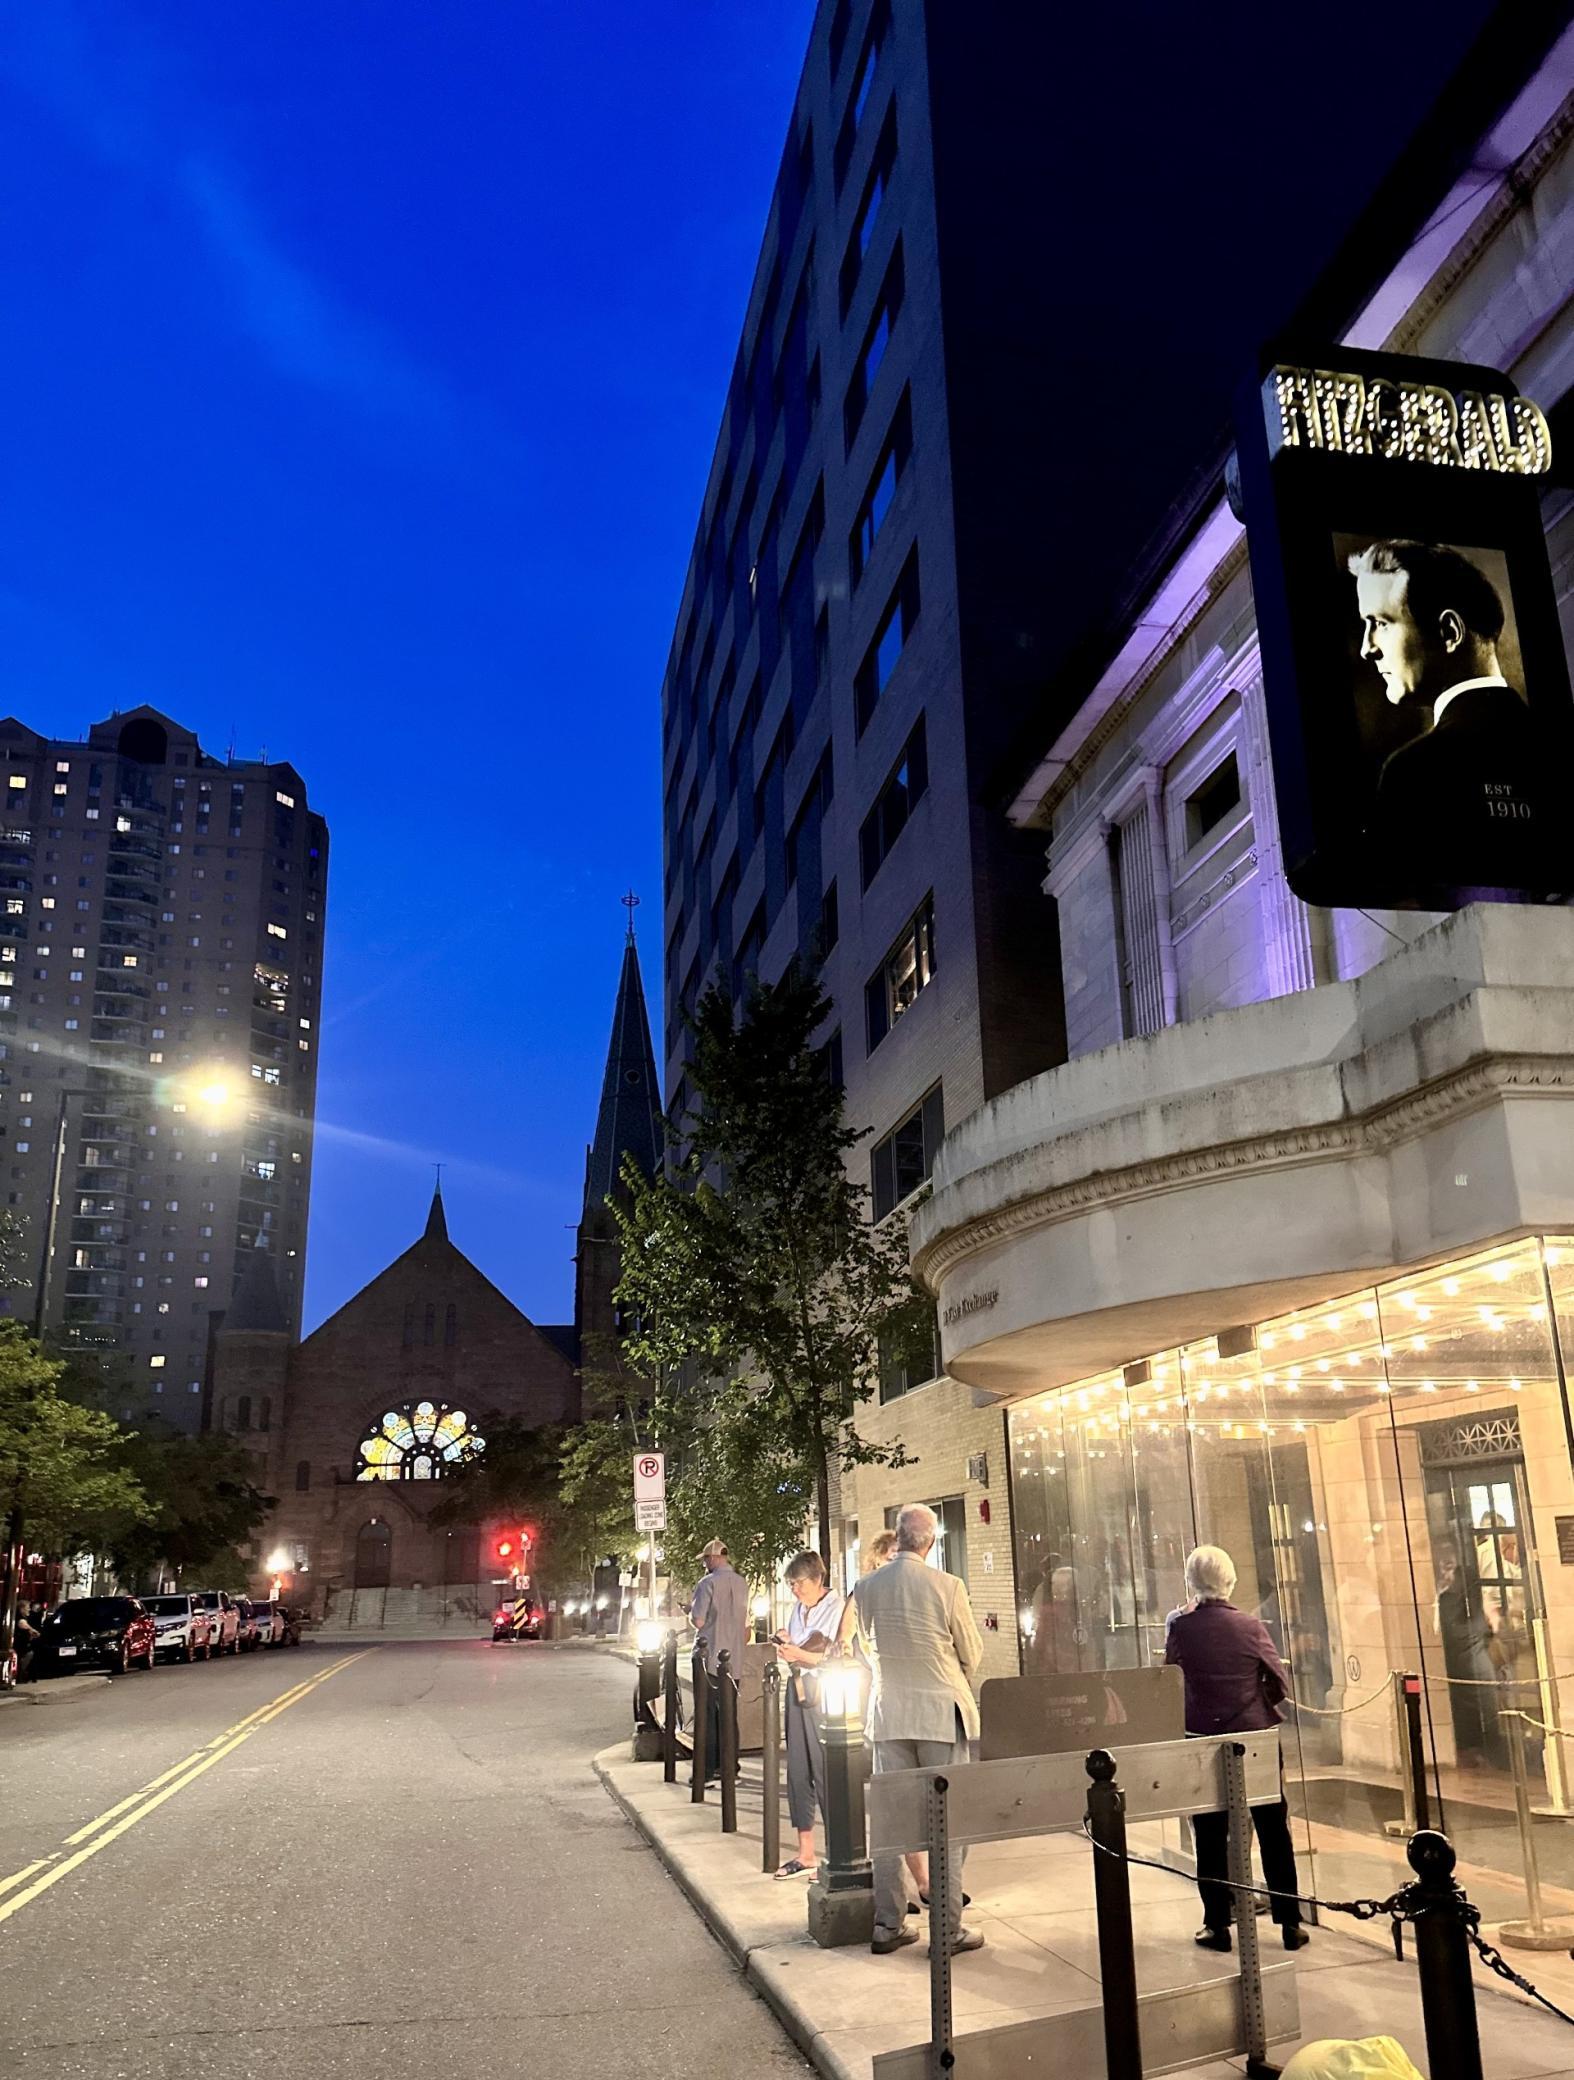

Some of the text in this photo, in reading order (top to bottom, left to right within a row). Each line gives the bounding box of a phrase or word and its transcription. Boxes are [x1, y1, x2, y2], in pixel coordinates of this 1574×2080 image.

[1270, 364, 1552, 474] FITZGERALD
[1484, 783, 1512, 796] EST
[1487, 801, 1531, 819] 1910
